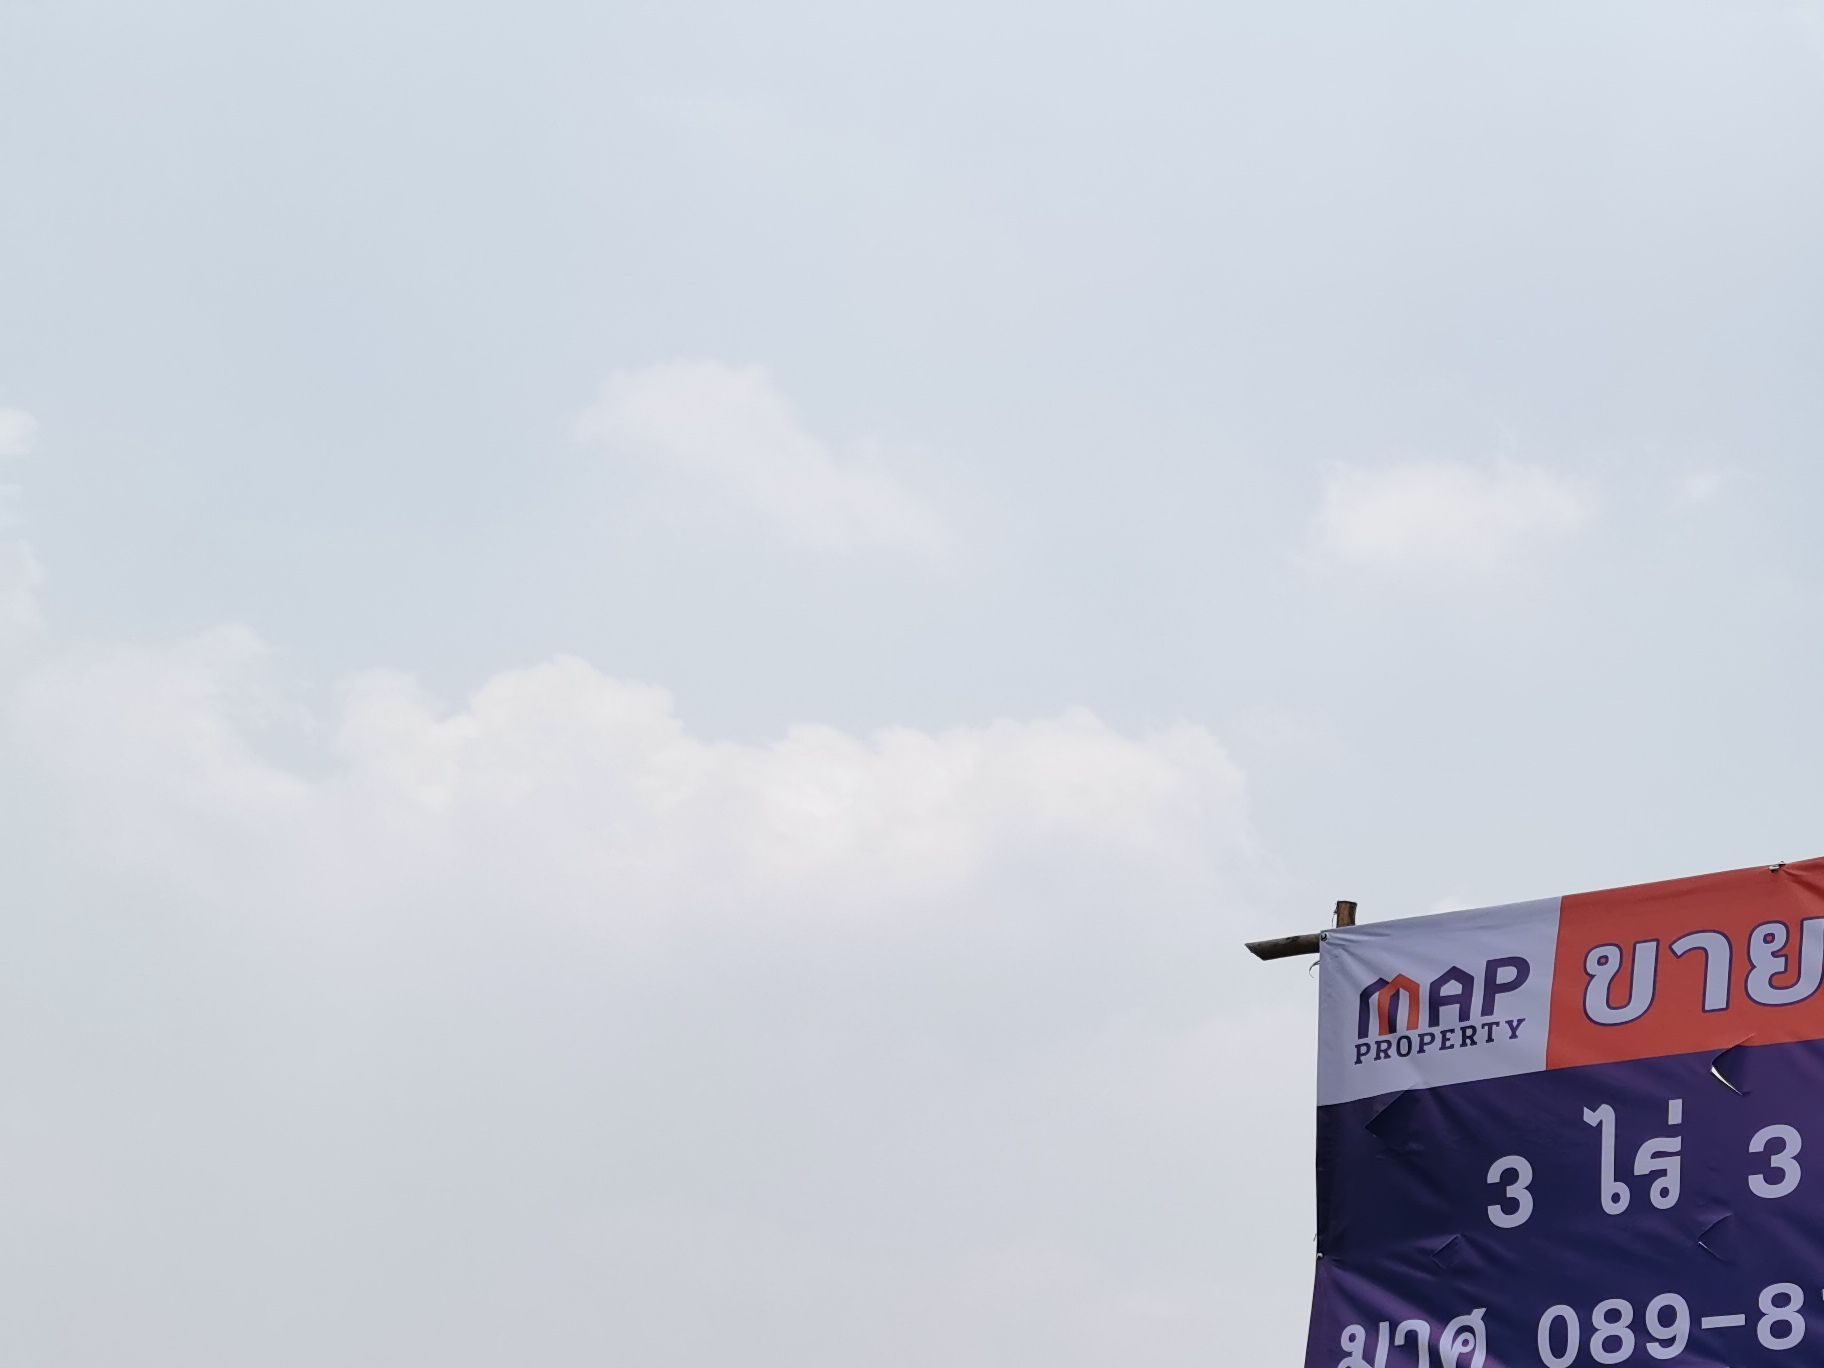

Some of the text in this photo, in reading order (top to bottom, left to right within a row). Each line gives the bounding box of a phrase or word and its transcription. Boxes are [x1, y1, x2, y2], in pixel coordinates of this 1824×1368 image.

[1357, 956, 1531, 1040] MAP
[1353, 1018, 1526, 1065] PROPERTY
[1486, 1155, 1534, 1229] 3
[1583, 1098, 1683, 1216] ไร่
[1747, 1124, 1803, 1199] 3
